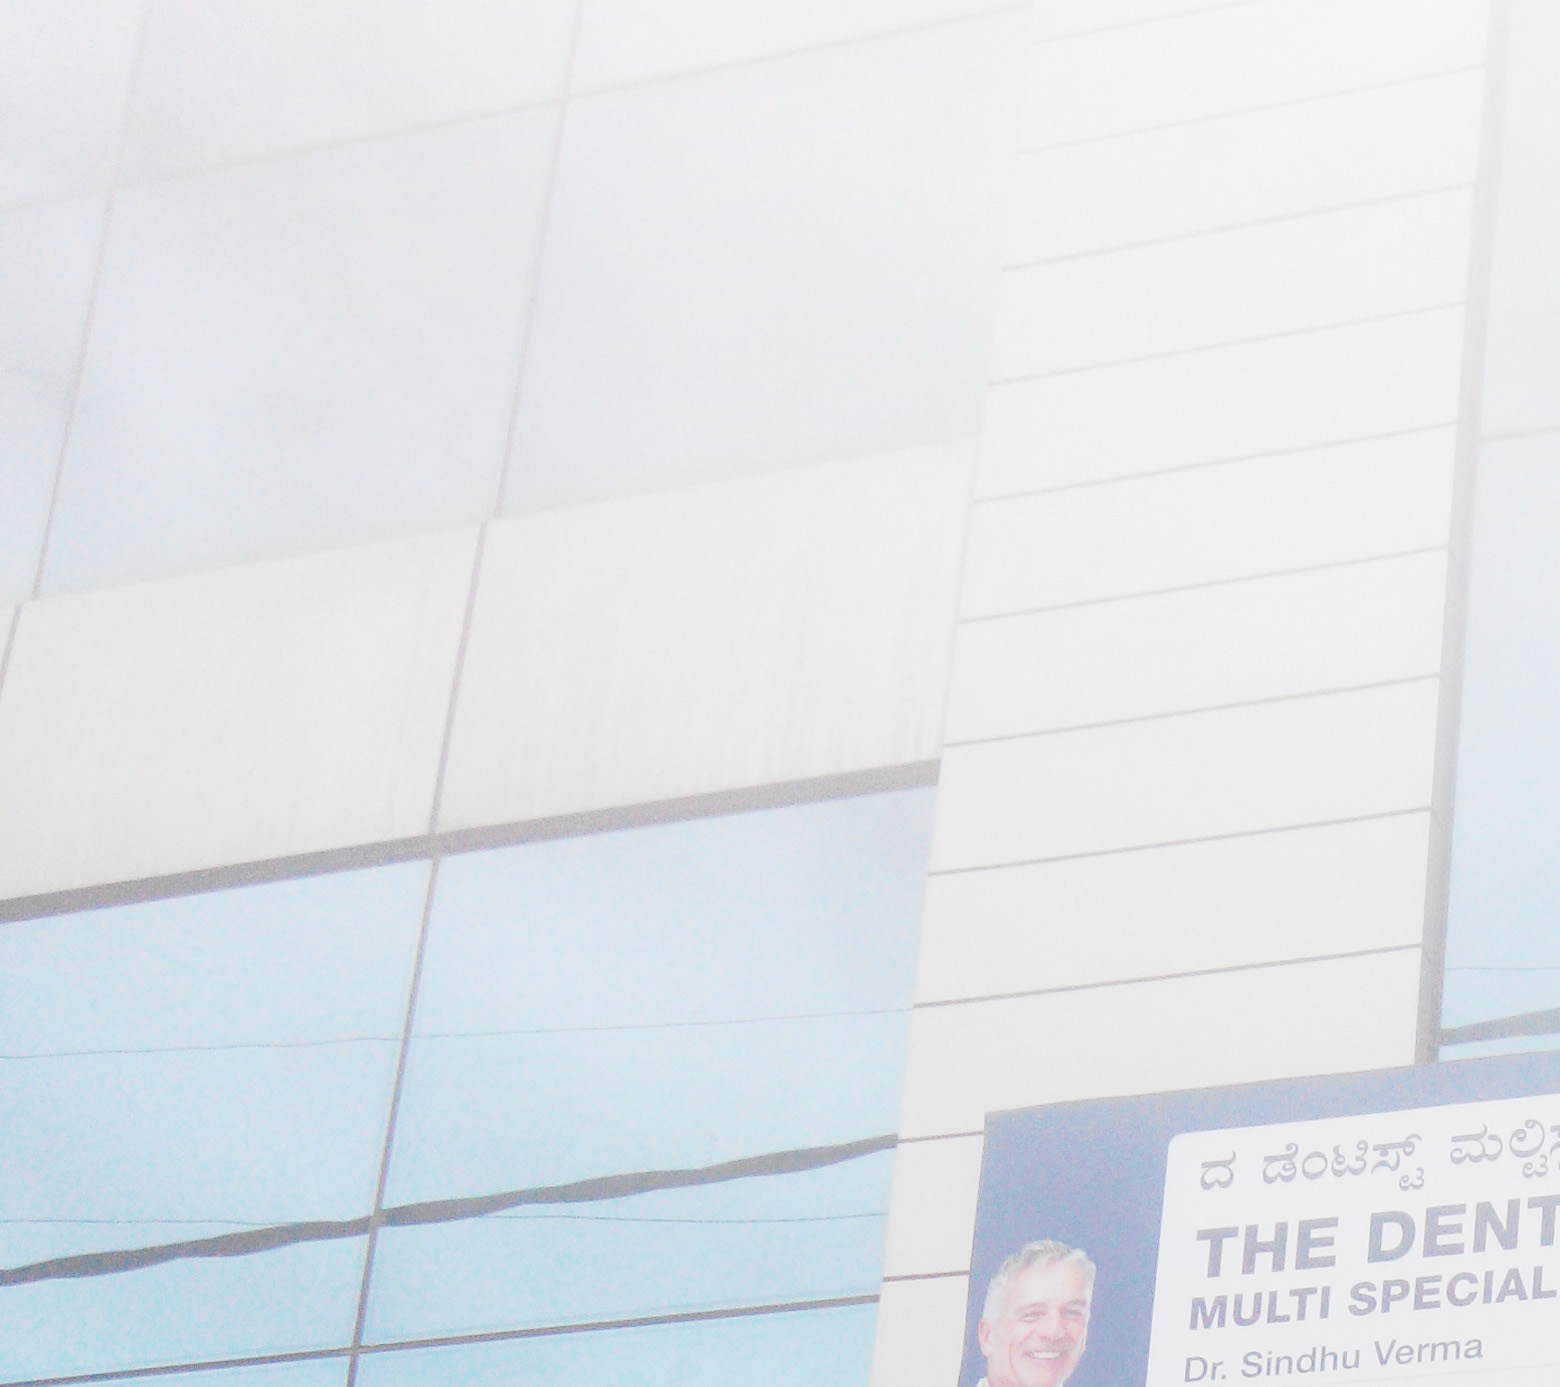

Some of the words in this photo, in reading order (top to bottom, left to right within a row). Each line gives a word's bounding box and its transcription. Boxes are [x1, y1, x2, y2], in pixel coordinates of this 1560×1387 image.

[1199, 1149, 1237, 1191] ದ
[1196, 1216, 1339, 1279] THE
[1189, 1286, 1332, 1332] MULTI
[1184, 1355, 1228, 1384] Dr.
[1240, 1346, 1360, 1379] Sindhu
[1373, 1338, 1485, 1368] Verma
